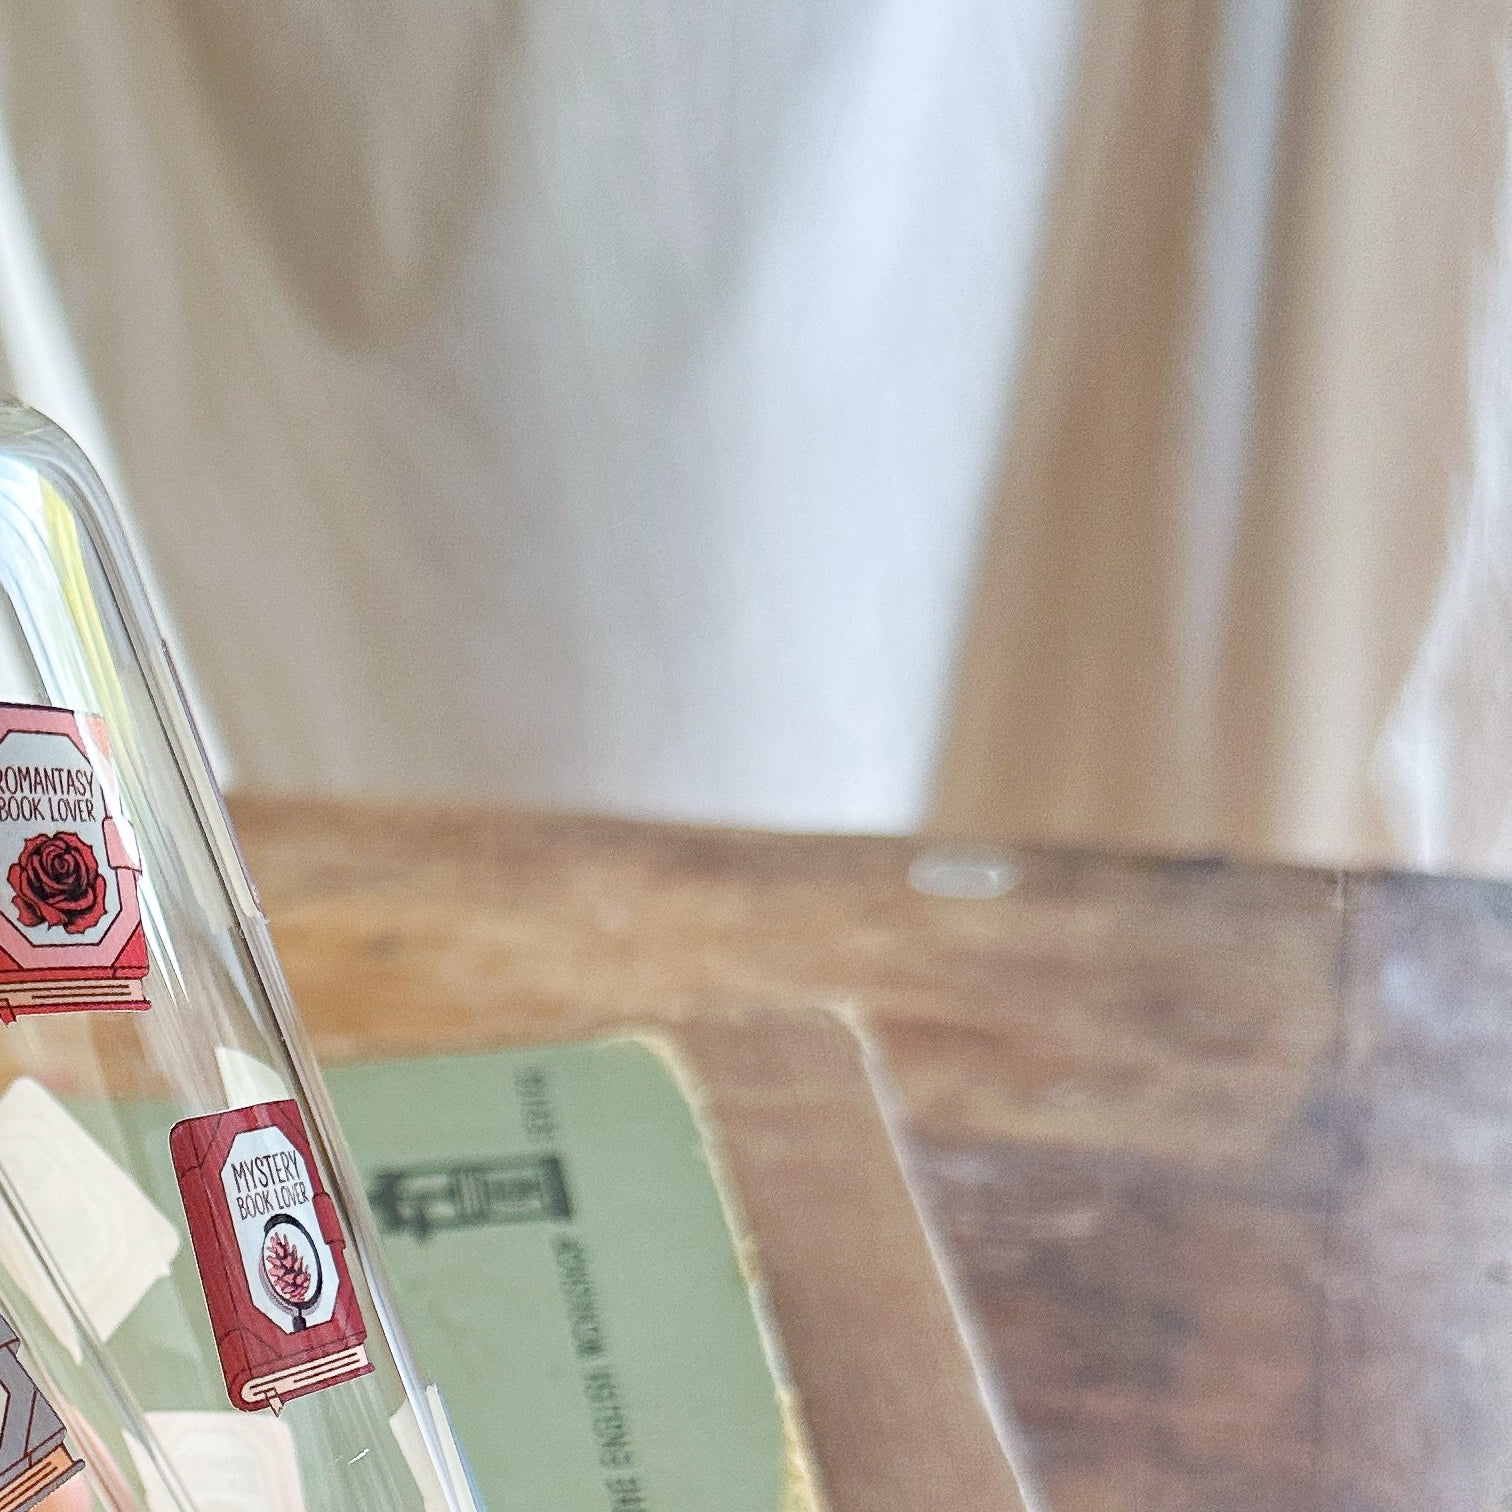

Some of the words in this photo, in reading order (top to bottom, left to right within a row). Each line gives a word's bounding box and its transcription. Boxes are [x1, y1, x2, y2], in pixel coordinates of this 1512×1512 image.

[48, 797, 97, 824] LOVER
[230, 1150, 301, 1194] MYSTERY
[236, 1189, 275, 1221] BOOK
[273, 1181, 310, 1210] LOVER
